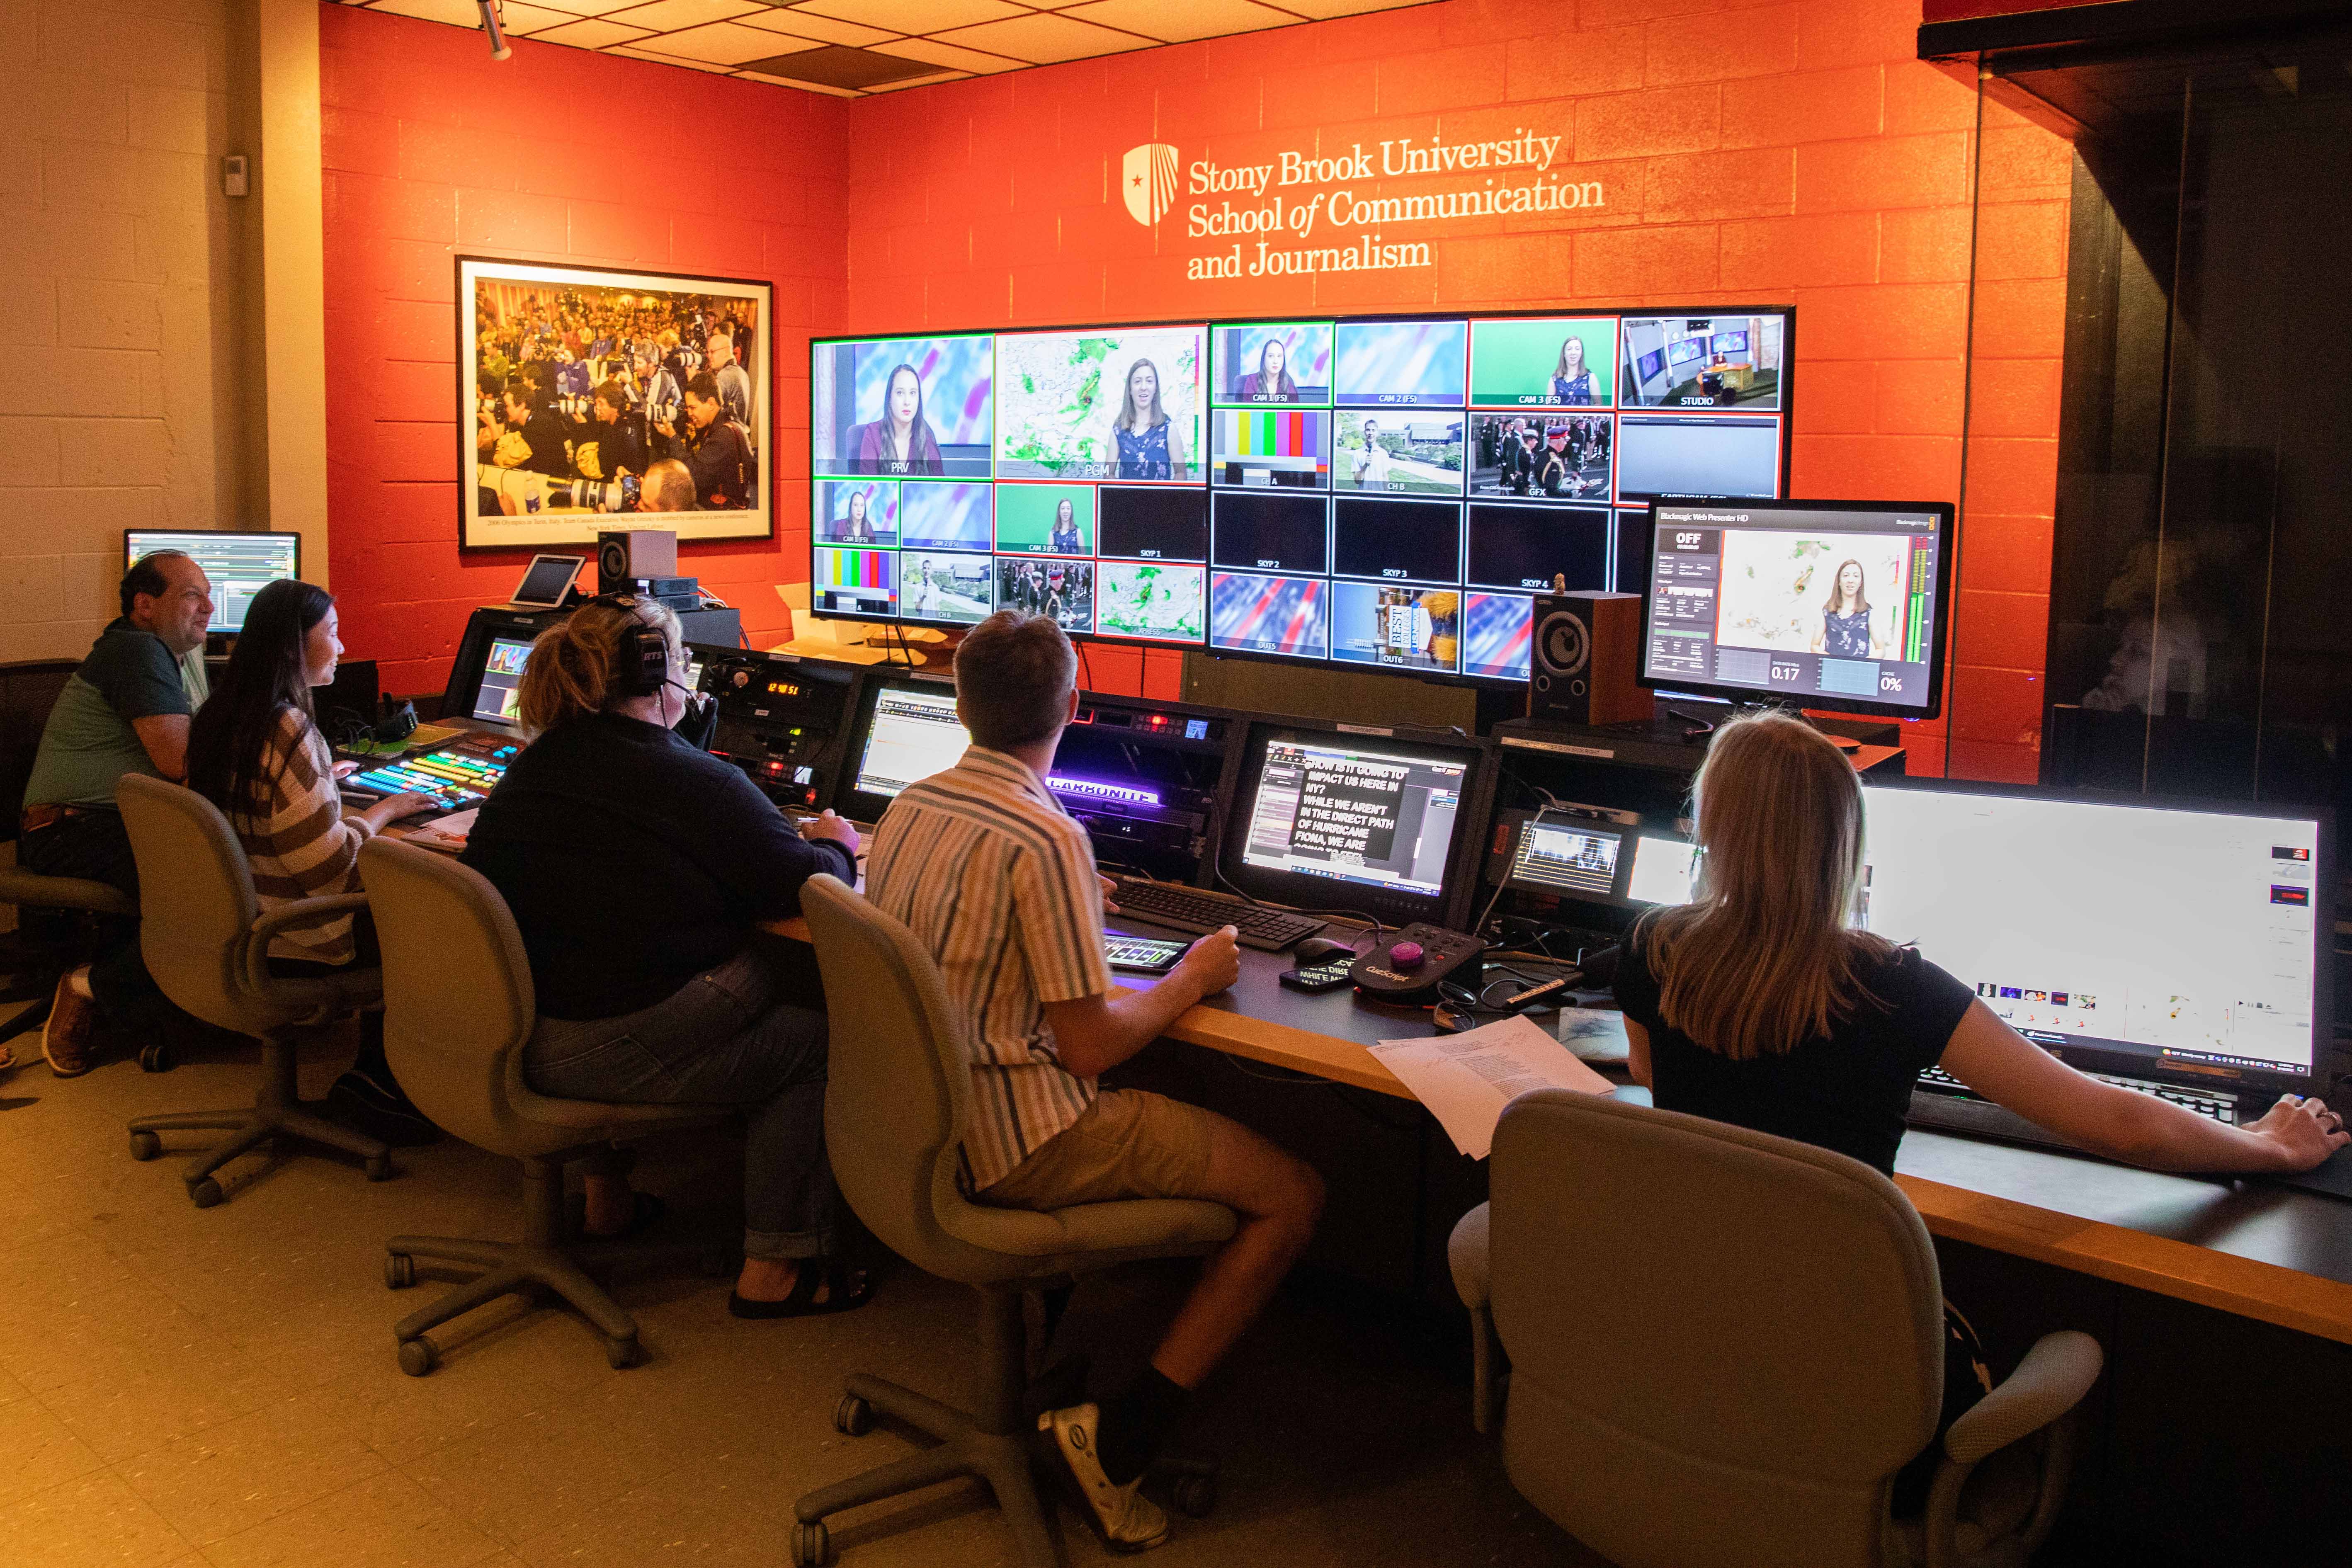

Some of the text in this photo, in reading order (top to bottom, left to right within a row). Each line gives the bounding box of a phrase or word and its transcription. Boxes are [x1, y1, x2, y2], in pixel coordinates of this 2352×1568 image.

[1189, 127, 1561, 197] Stony Brook University
[1188, 173, 1604, 238] School of Communication
[1187, 235, 1432, 281] and Journalism
[1403, 395, 1417, 403] (FS)
[1546, 396, 1561, 405] (FS)
[1681, 397, 1714, 405] STUDIO
[891, 462, 909, 473] PRV
[1085, 464, 1109, 476] PGM
[1660, 512, 1692, 521] Blackmagic
[1676, 533, 1701, 544] OFF
[1383, 568, 1400, 577] SKYP
[1522, 579, 1549, 588] SKYP 4
[1392, 609, 1402, 643] BEST
[1383, 655, 1403, 663] OUT6
[1771, 666, 1800, 680] 0.17
[1880, 677, 1902, 692] 0%
[1305, 783, 1326, 794] NY?
[1308, 771, 1399, 792] IMPACT US HERE IN
[1303, 795, 1335, 808] WHILE
[1335, 799, 1351, 811] WE
[1300, 807, 1395, 830] IN THE DIRECT PATH
[1298, 819, 1370, 839] OF HURRICANE
[1295, 831, 1367, 851] FIONA, WE ARE
[1366, 966, 1410, 982] CueScript
